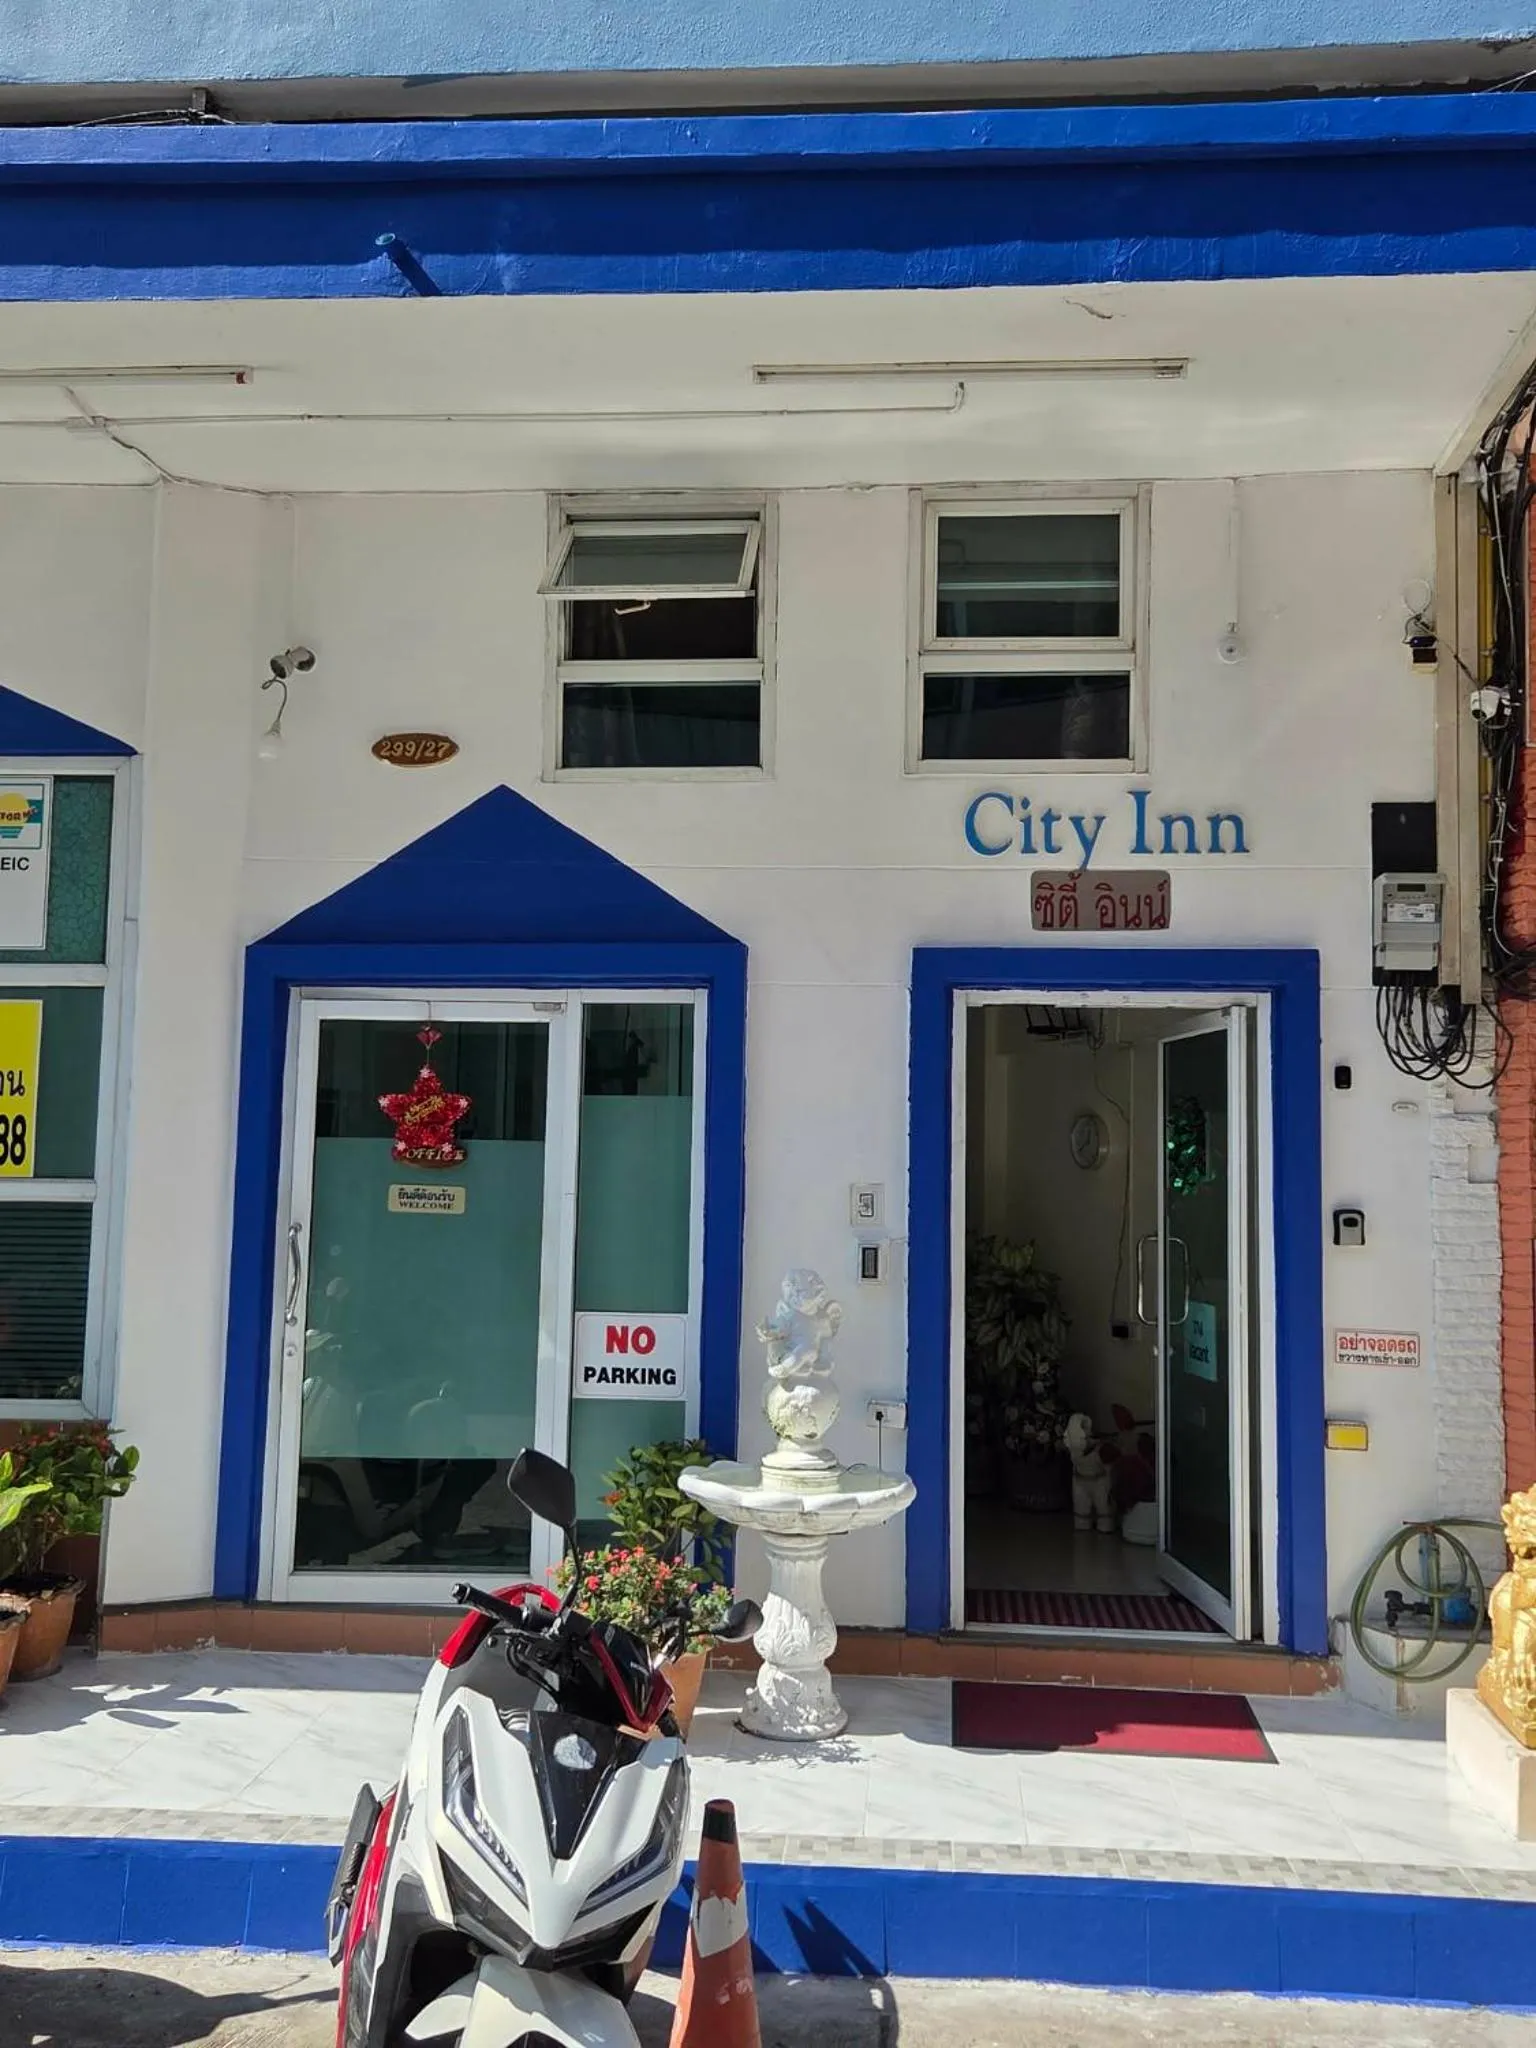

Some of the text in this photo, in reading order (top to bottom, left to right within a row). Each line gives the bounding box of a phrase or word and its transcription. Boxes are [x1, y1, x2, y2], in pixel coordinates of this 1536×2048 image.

[380, 740, 450, 761] 299/27
[964, 790, 1250, 871] City Inn
[1034, 871, 1170, 930] ซิตี้ อินน์
[399, 1200, 455, 1211] WELCOME
[606, 1325, 656, 1354] NO
[1338, 1332, 1417, 1354] อย่าจอดรถ
[583, 1366, 677, 1386] PARKING
